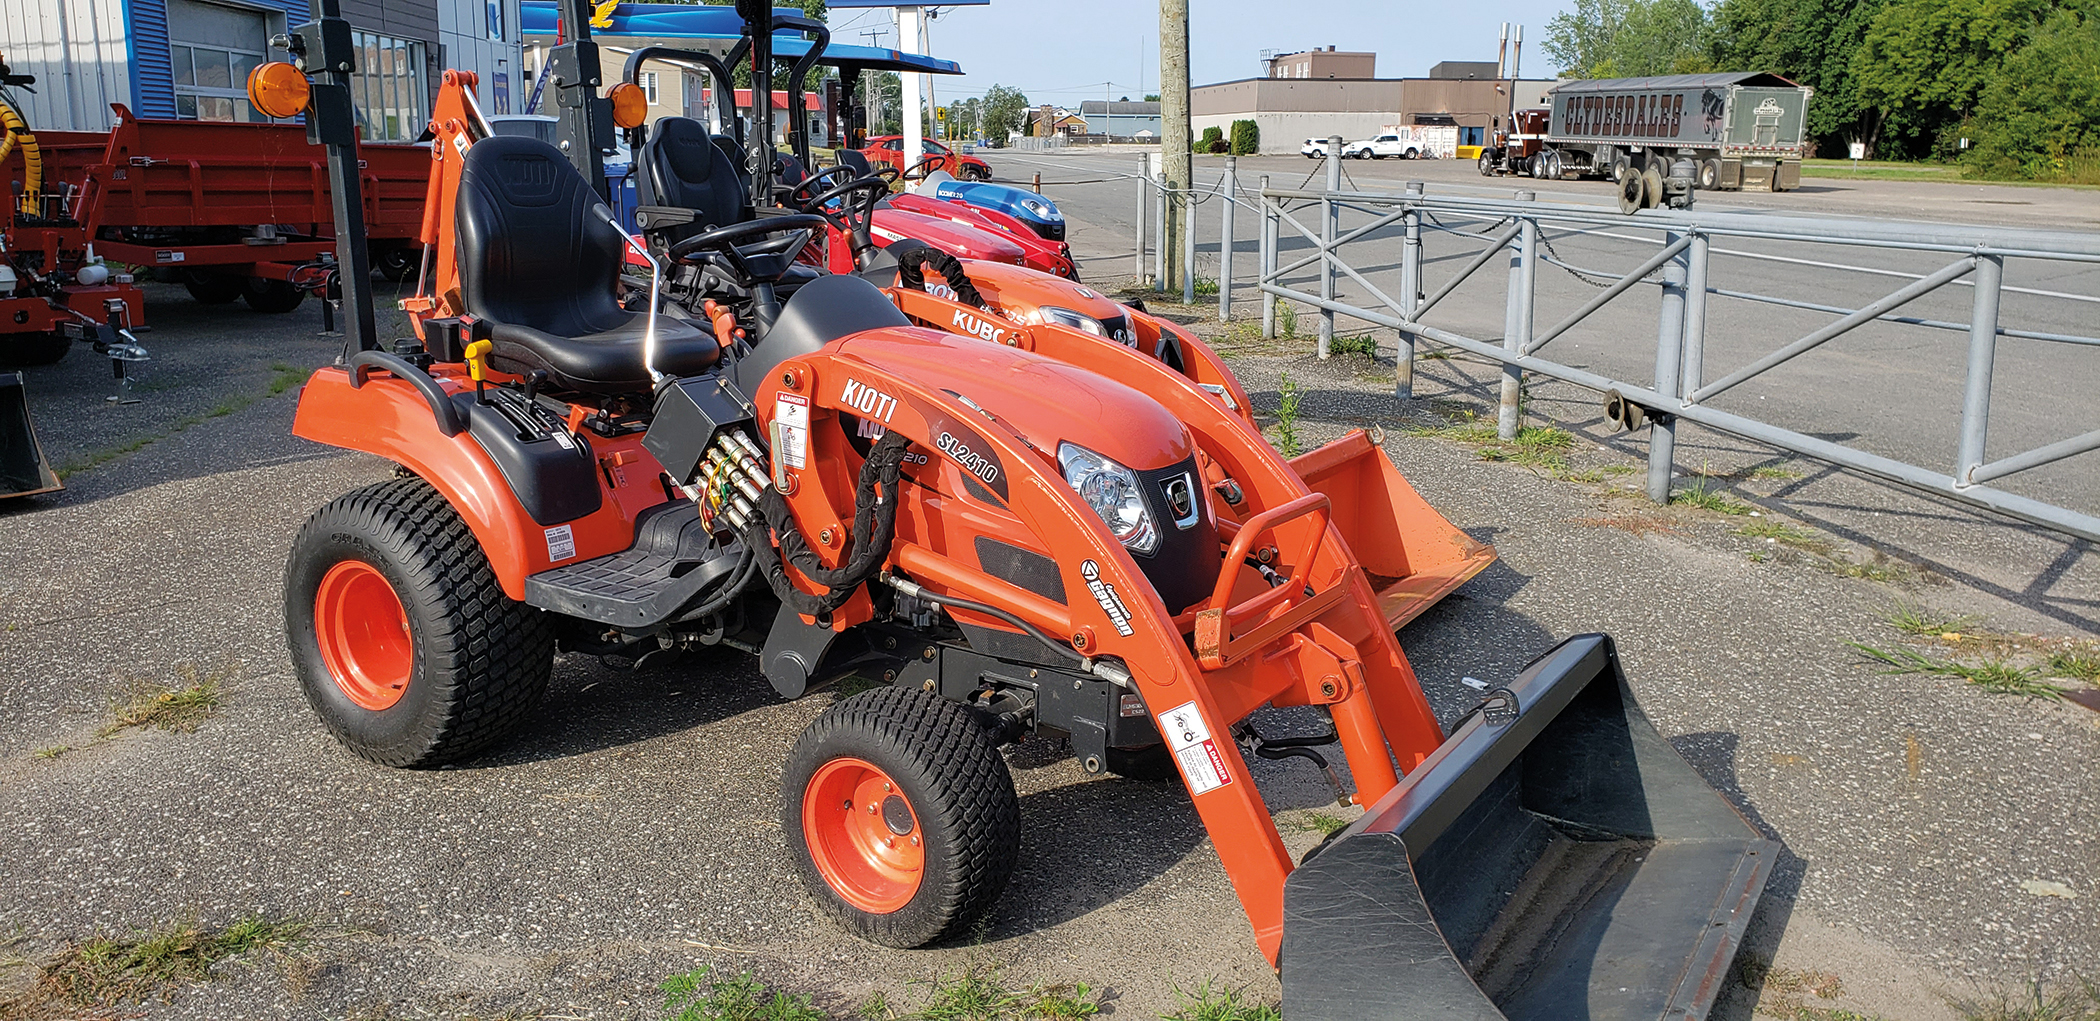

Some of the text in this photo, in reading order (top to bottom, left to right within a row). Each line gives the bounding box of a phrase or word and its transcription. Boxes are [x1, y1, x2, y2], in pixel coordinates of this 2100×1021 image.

[1565, 94, 1684, 138] CLYDESDALES
[784, 394, 806, 405] DANGER
[840, 377, 898, 424] KIOTI
[936, 432, 999, 484] SL2410
[1088, 579, 1135, 636] Gagnon
[1209, 750, 1228, 781] DANGER
